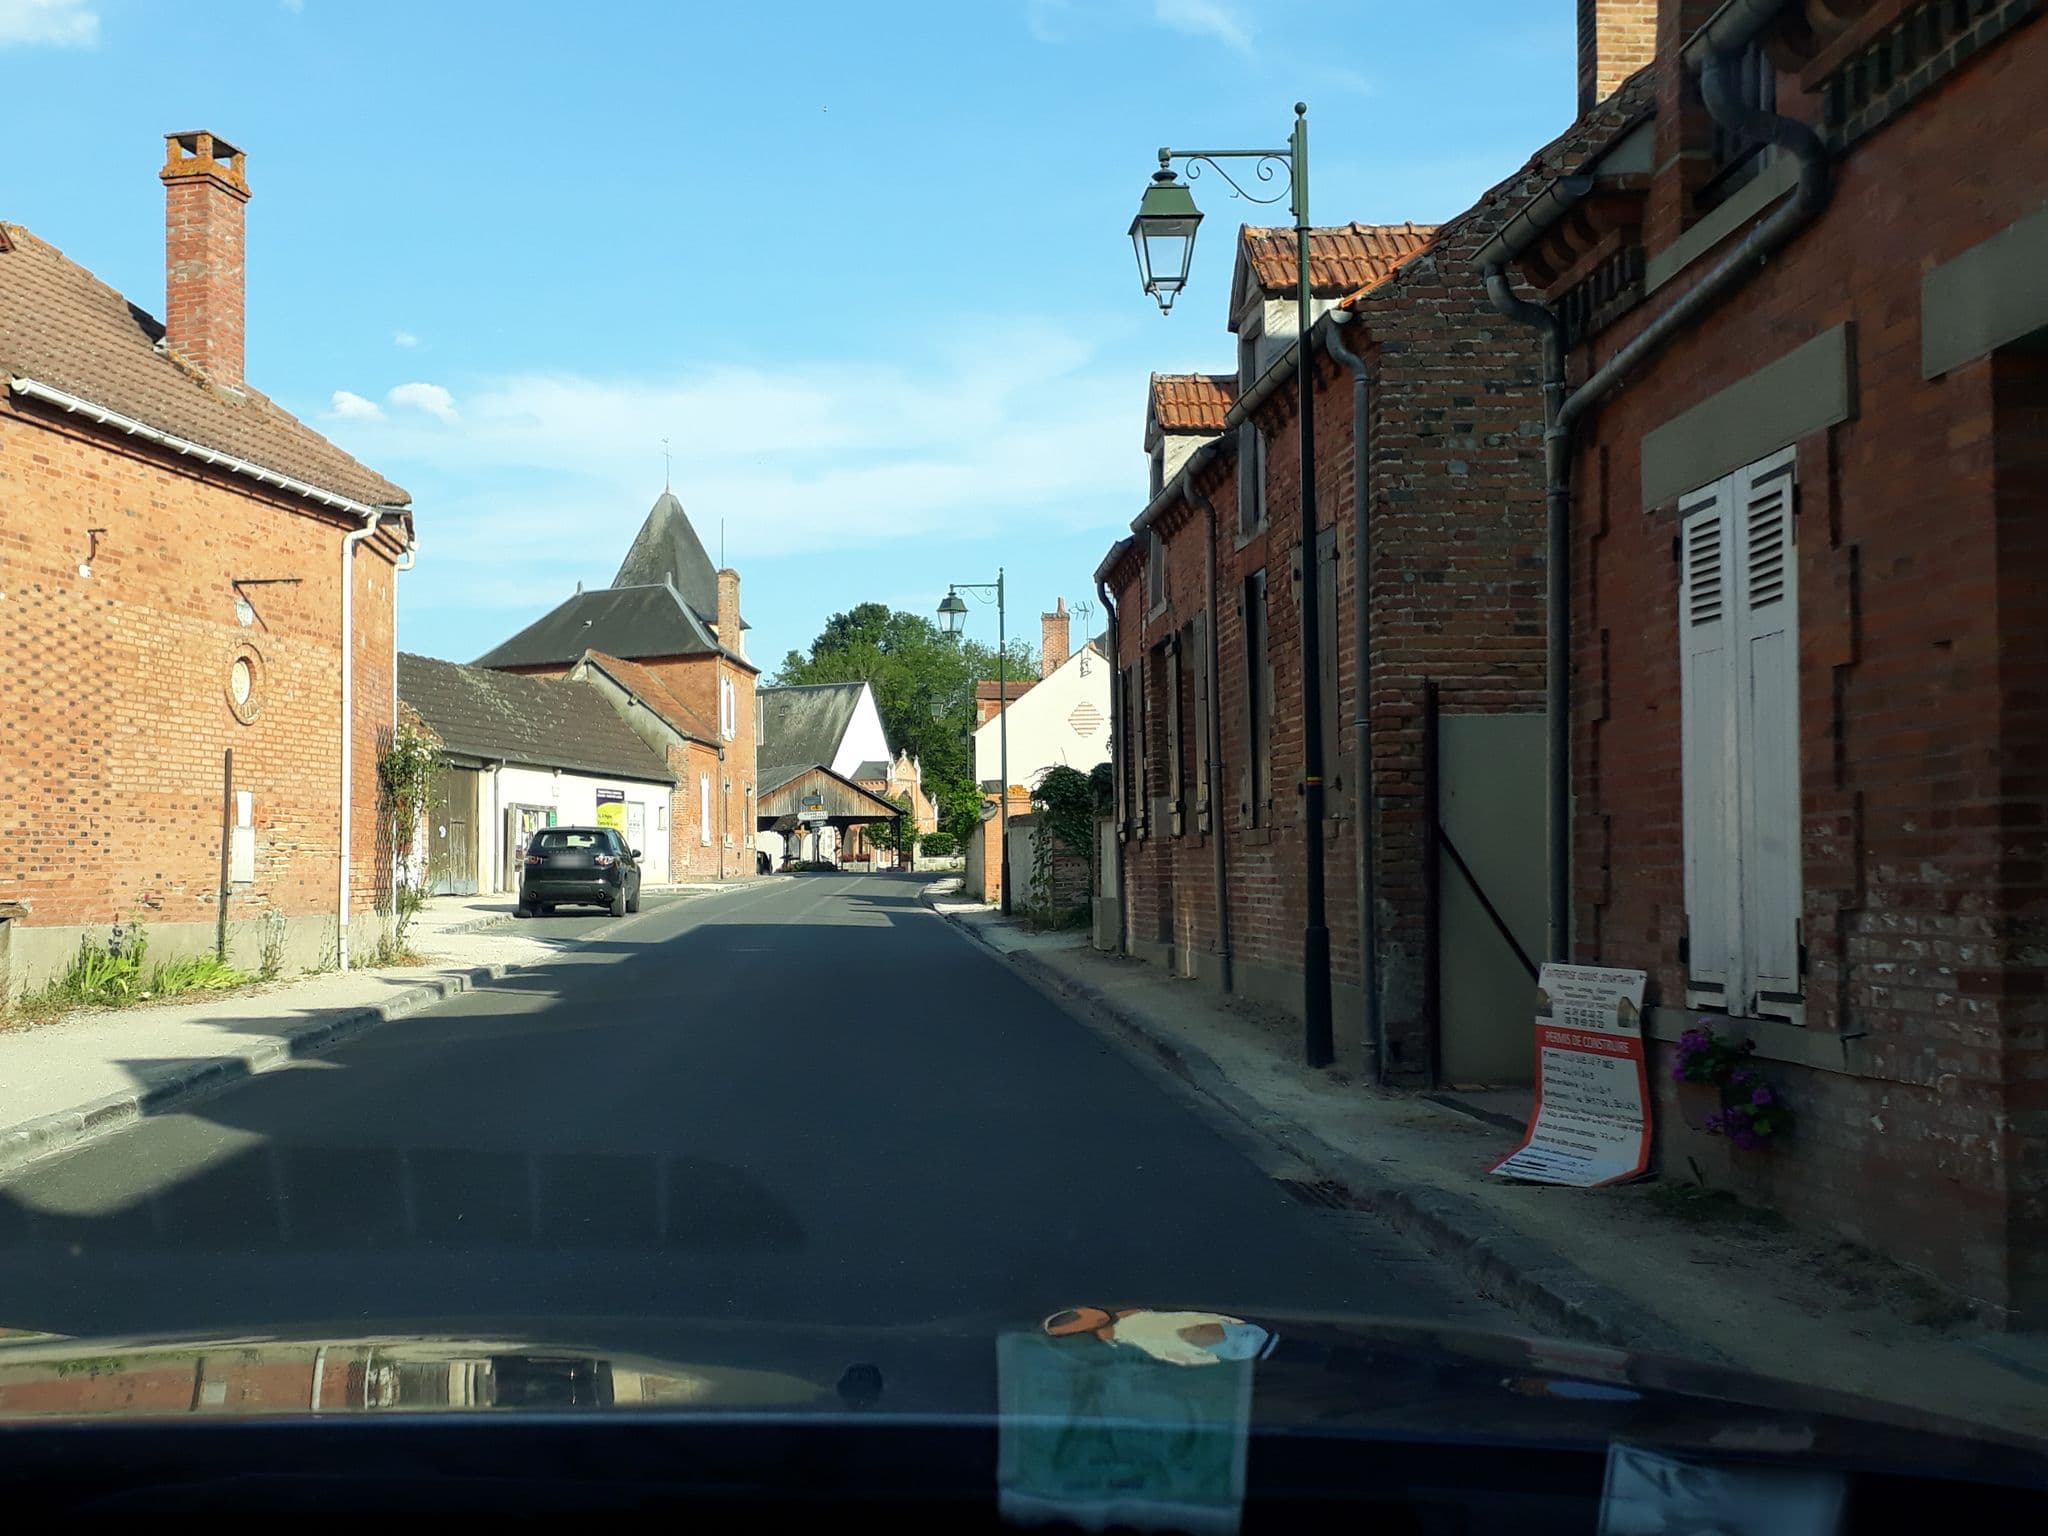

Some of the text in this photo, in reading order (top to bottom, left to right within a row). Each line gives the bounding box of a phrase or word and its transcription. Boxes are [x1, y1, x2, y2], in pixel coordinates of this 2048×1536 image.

[1545, 1031, 1630, 1054] PERMIS DE CONSTRUIRE
